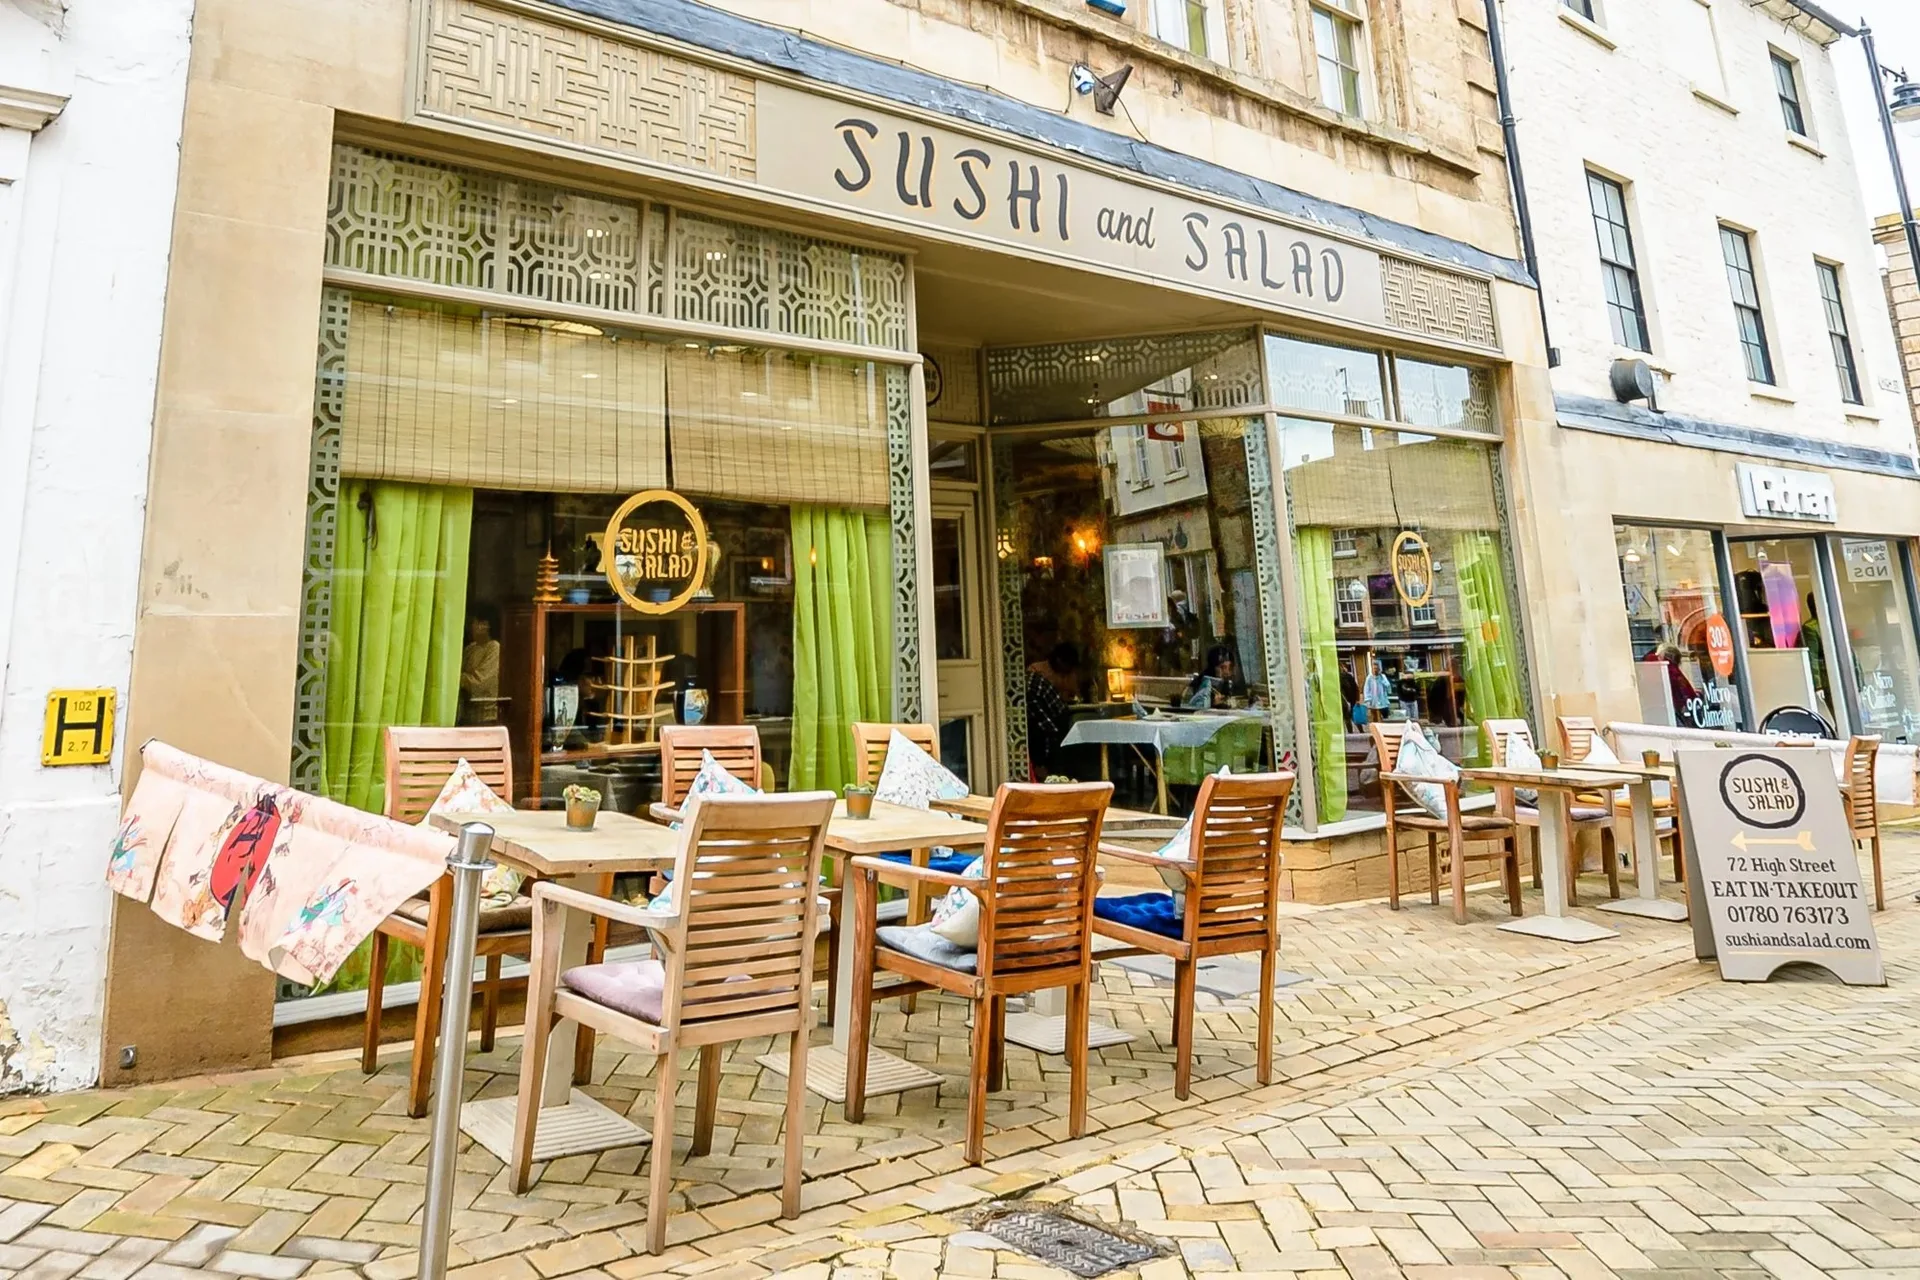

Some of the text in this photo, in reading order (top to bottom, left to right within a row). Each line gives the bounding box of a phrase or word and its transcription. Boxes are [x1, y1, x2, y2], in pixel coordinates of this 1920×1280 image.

[833, 117, 1345, 303] SUSHI and SALAD
[619, 527, 678, 554] SUSHI
[633, 553, 693, 579] SALAD
[1703, 681, 1731, 703] Micro
[73, 700, 93, 712] 102
[53, 696, 107, 757] H
[1732, 777, 1782, 794] SUSHI
[1747, 795, 1795, 811] SALAD
[1727, 857, 1836, 876] 72 High Street
[1711, 881, 1747, 898] EAT
[1727, 906, 1850, 925] 01780 763173
[1725, 932, 1871, 950] sushiandsalad.com
